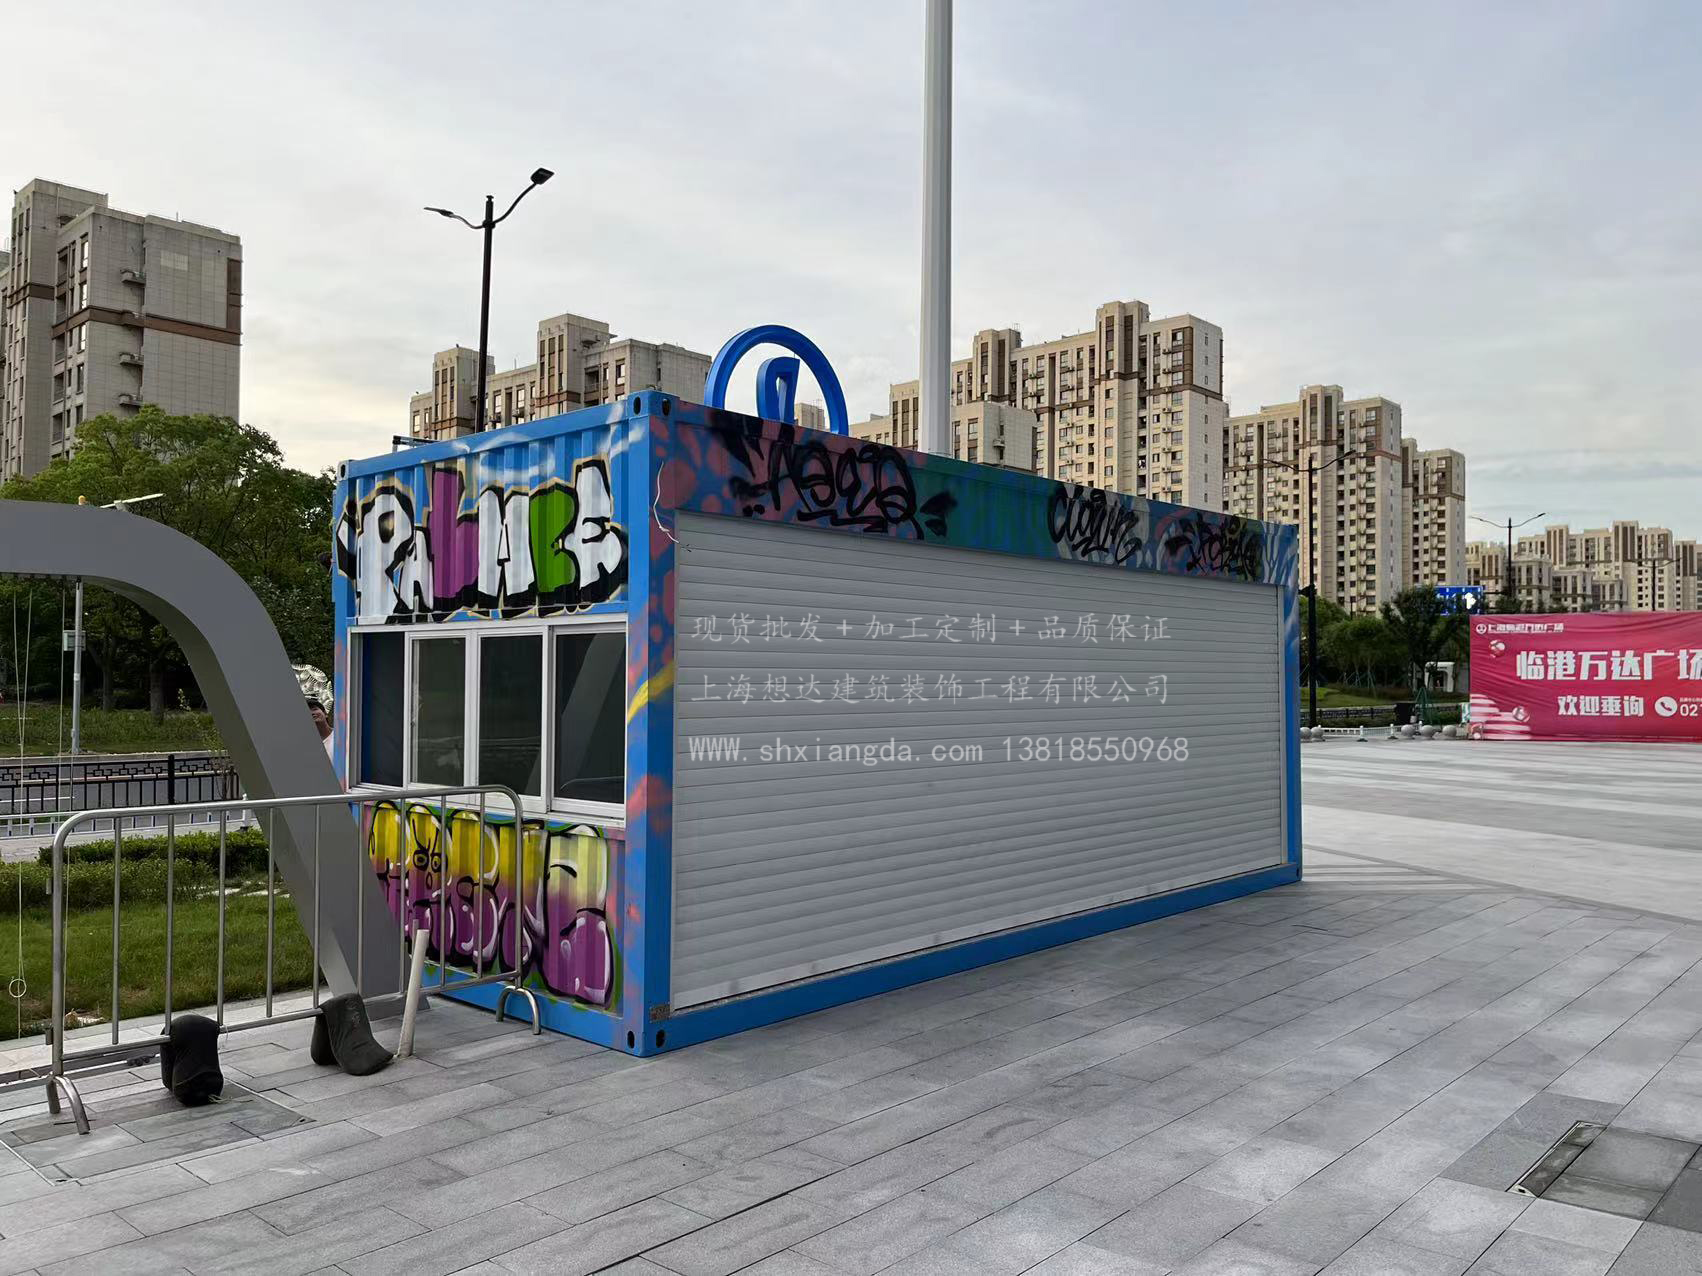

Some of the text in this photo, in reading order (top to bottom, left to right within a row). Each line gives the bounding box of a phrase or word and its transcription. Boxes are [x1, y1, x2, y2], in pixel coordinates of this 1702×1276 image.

[1516, 650, 1702, 681] 临港万达广场
[1558, 695, 1644, 717] 欢迎垂询
[1680, 703, 1702, 717] 02
